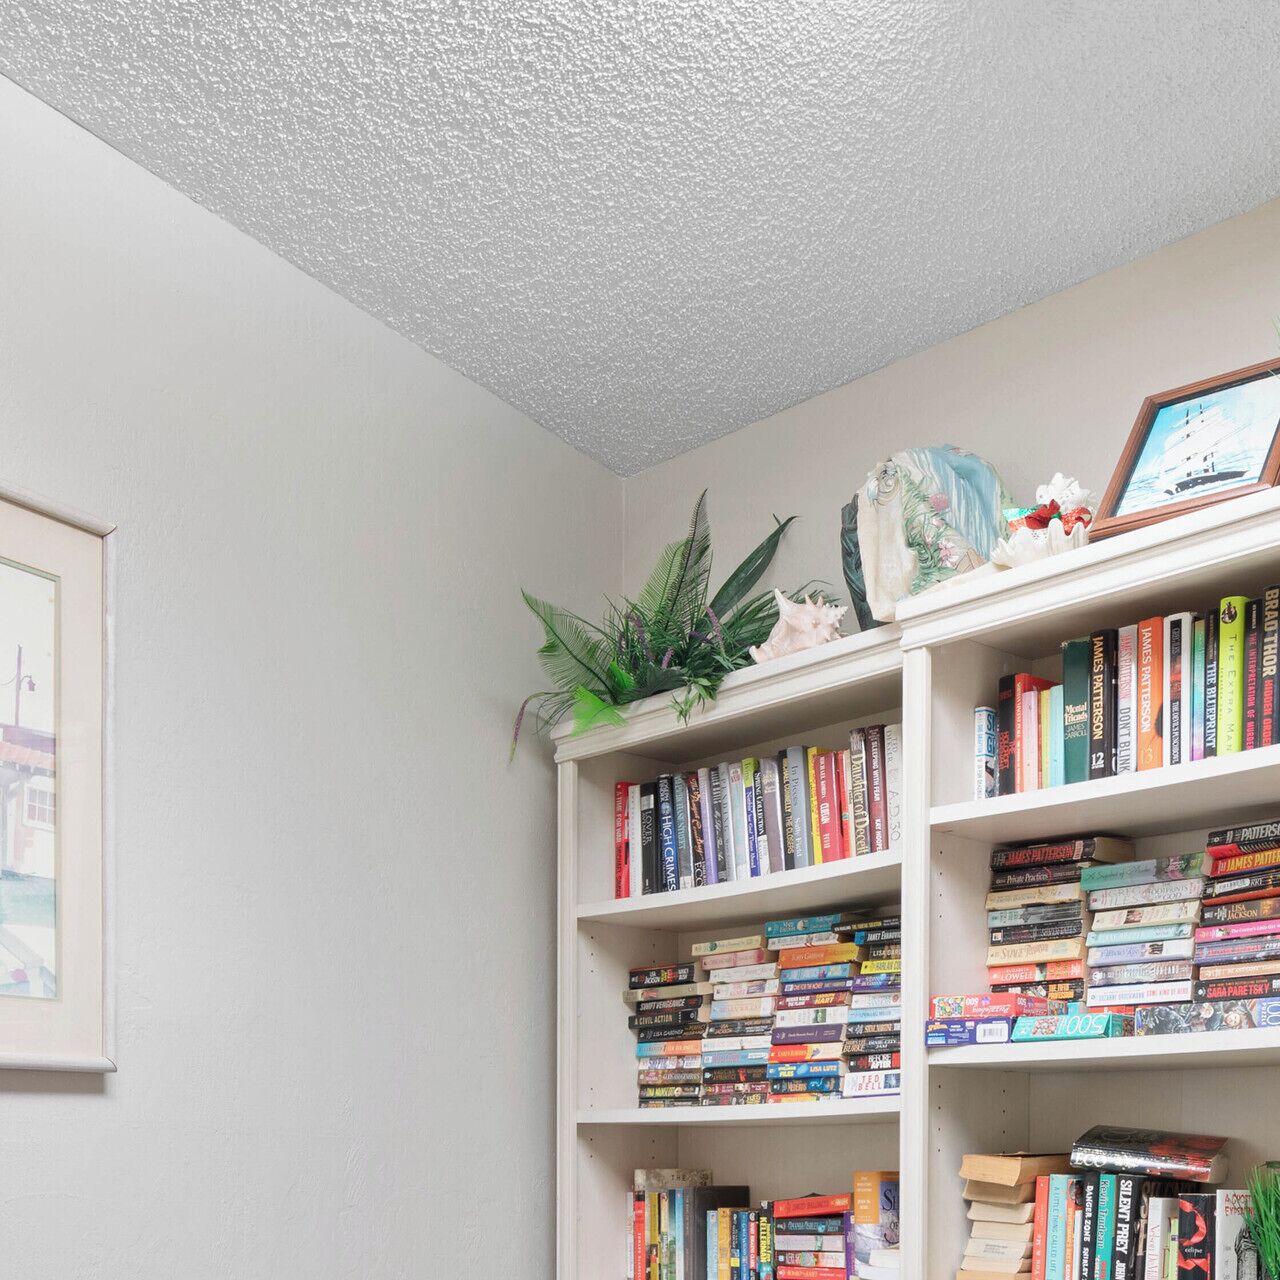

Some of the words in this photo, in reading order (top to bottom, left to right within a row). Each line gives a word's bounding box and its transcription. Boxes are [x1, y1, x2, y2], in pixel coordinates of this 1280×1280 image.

[1265, 589, 1280, 630] BRAD
[1262, 635, 1278, 678] THOR
[1227, 909, 1258, 919] JACKSON
[1207, 986, 1226, 997] SARA
[1226, 985, 1269, 997] PARETSKY
[1119, 1179, 1133, 1221] SILENT
[1116, 1223, 1130, 1254] PREY
